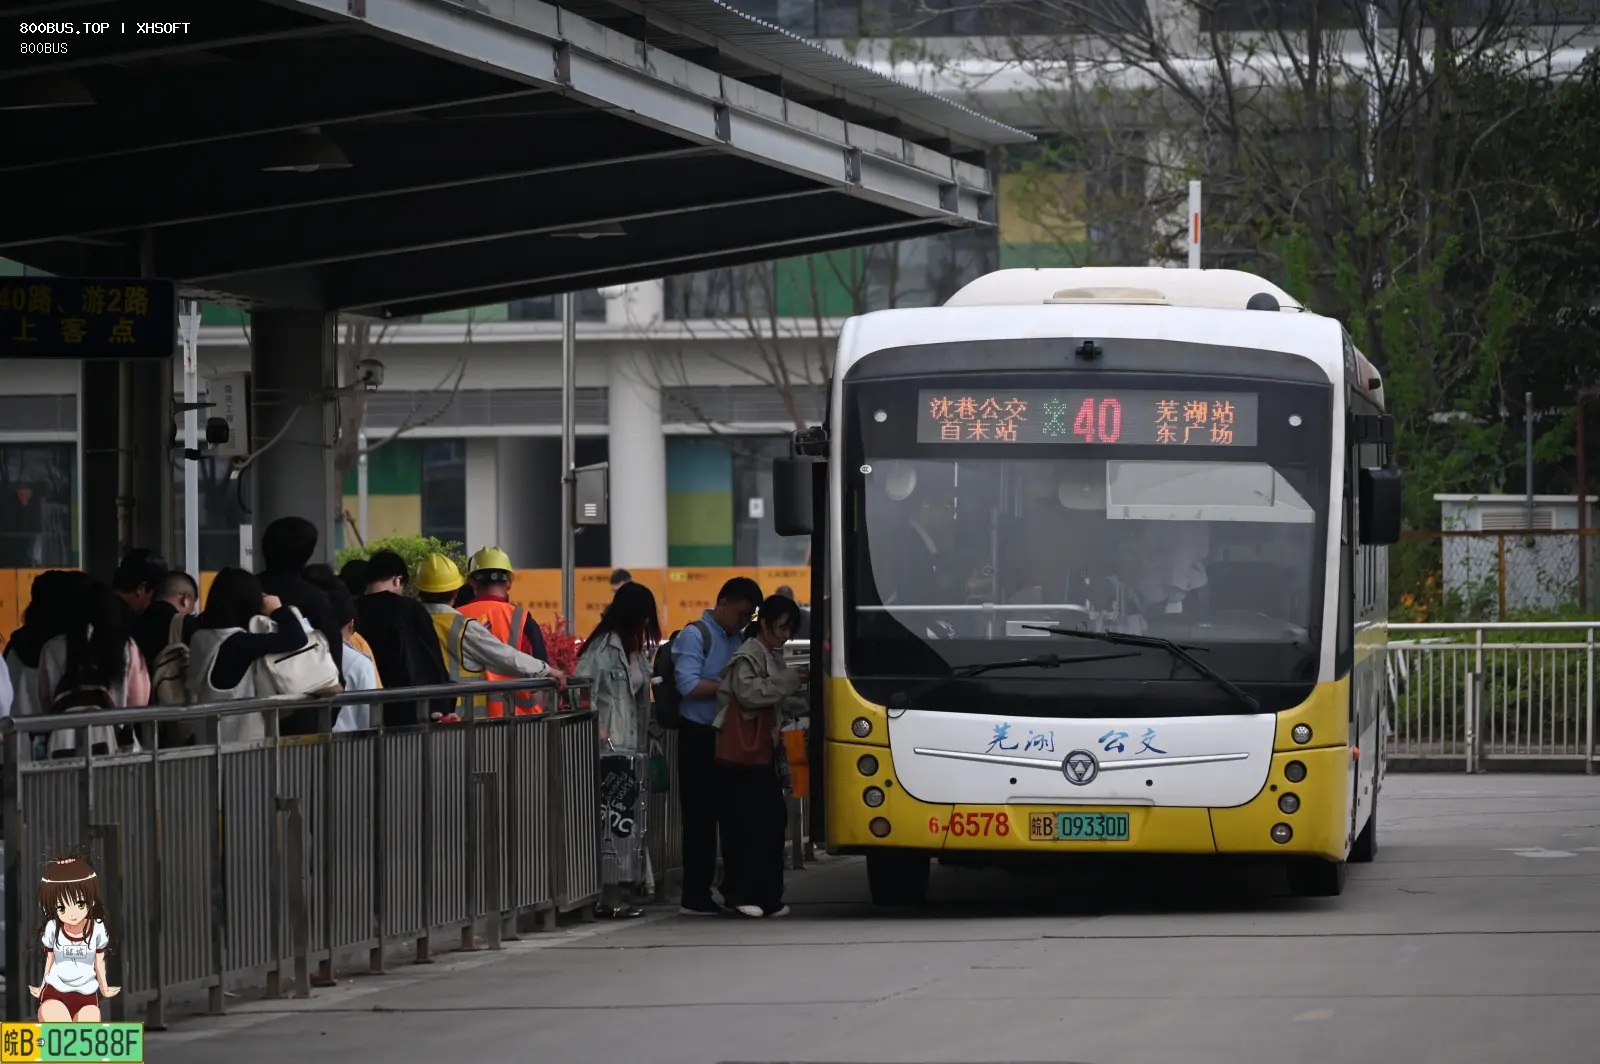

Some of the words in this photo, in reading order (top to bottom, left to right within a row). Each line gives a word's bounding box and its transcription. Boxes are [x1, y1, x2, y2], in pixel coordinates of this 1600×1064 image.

[12, 316, 136, 344] 上客点
[1072, 398, 1122, 444] 40
[1155, 400, 1236, 425] 芜湖站
[938, 420, 1020, 442] 首末站
[1155, 423, 1234, 445] 东广场
[928, 812, 1010, 837] 6-6578
